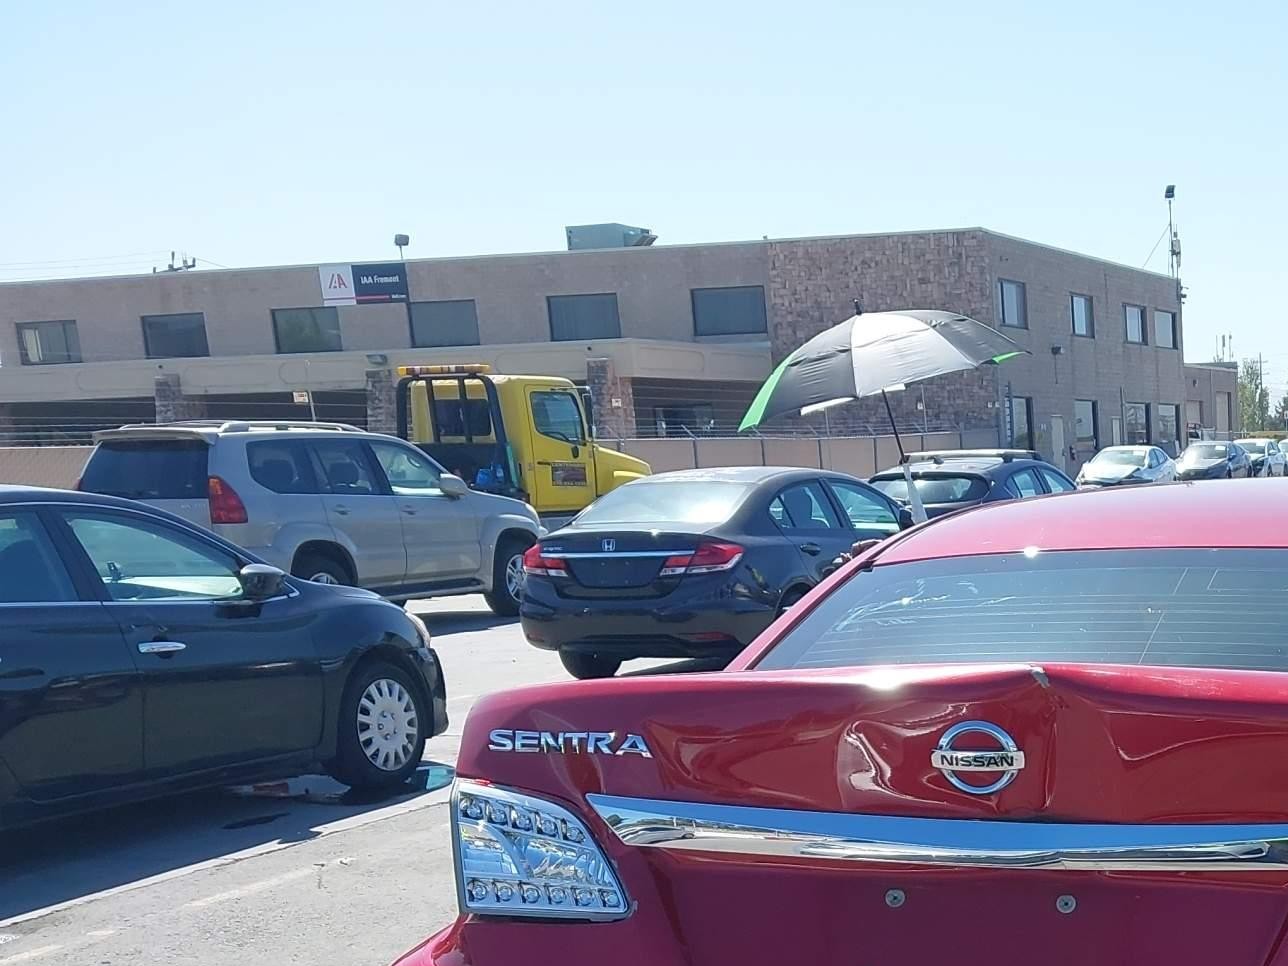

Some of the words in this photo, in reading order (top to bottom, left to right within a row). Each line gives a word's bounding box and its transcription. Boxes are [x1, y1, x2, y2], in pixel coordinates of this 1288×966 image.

[360, 275, 373, 284] IAA
[488, 729, 653, 759] SENTRA
[940, 754, 1014, 768] NISSAN
